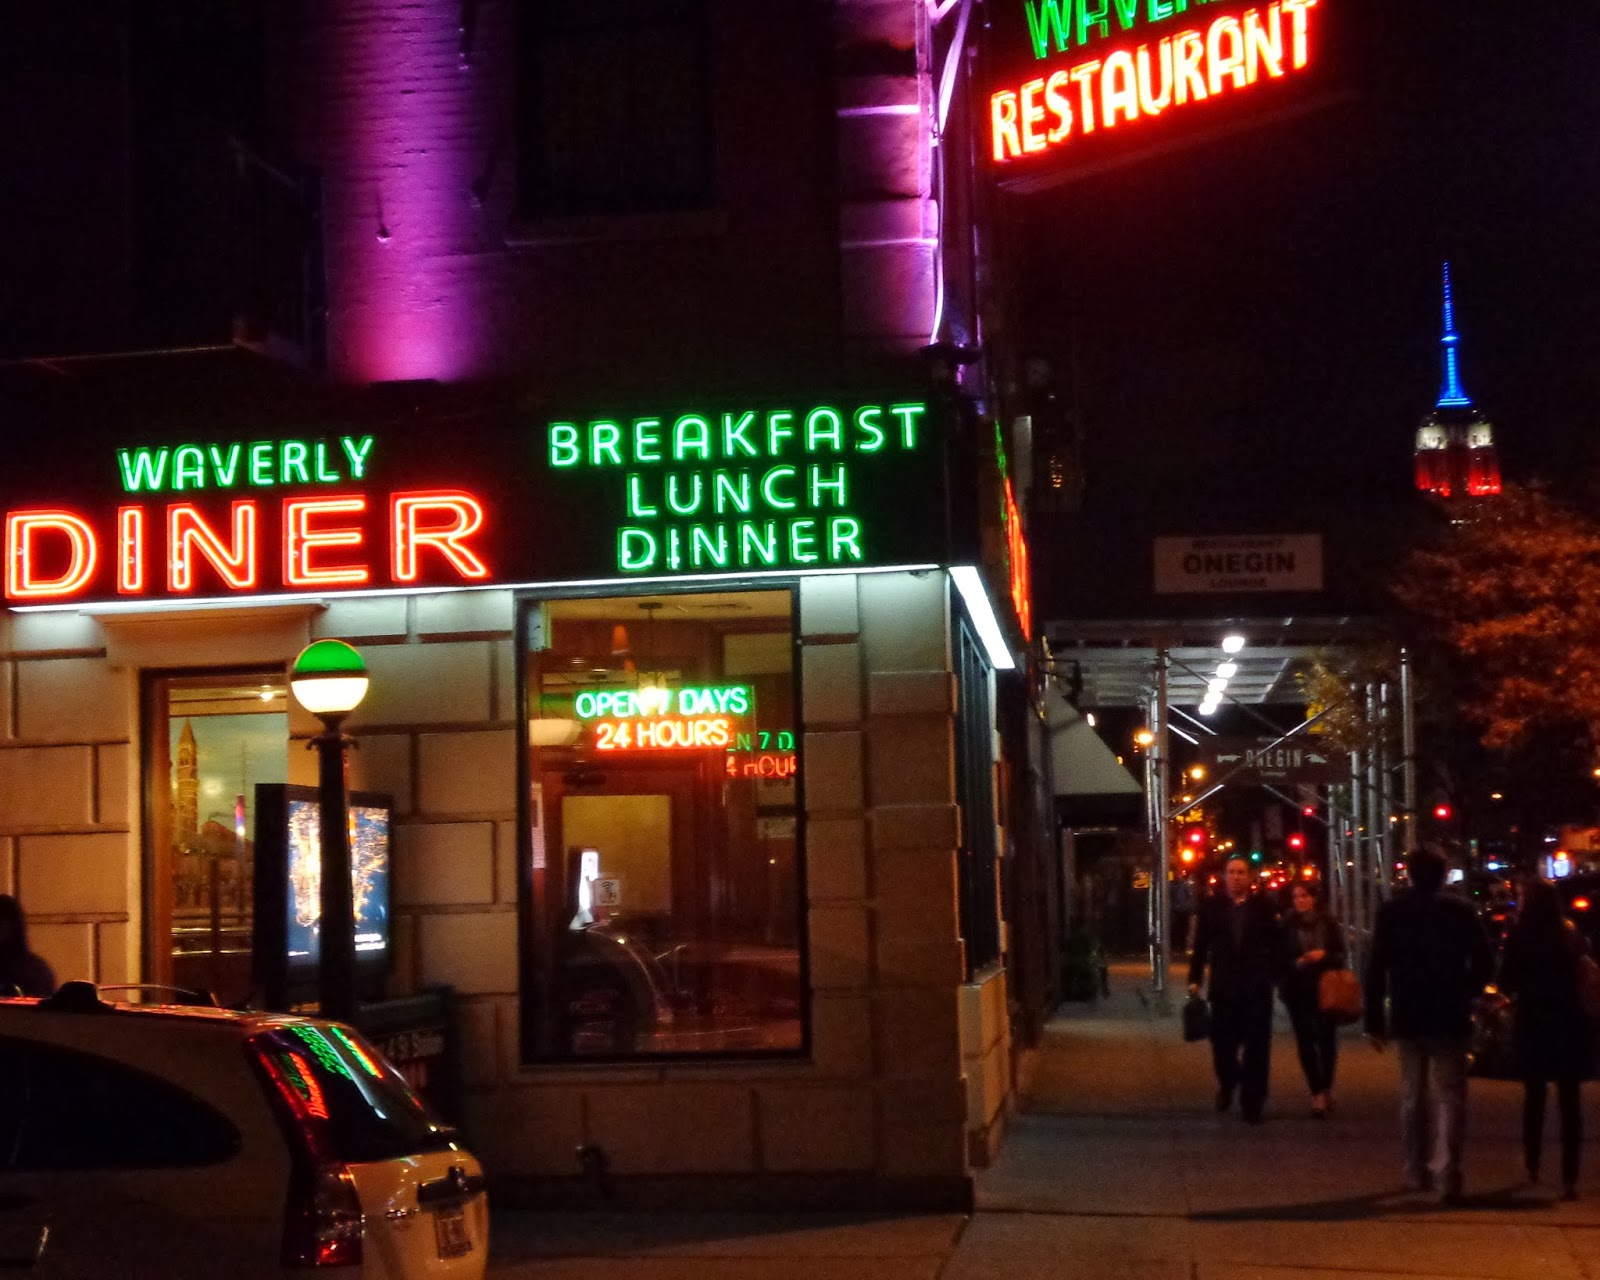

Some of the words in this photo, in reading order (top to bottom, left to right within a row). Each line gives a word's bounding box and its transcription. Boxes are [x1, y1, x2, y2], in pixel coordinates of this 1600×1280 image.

[991, 0, 1317, 161] RESTAURANT
[548, 403, 926, 467] BREAKFAST
[117, 435, 375, 491] WAVERLY
[626, 462, 846, 517] LUNCH
[5, 490, 492, 598] DINER
[617, 516, 863, 571] DINNER
[1183, 552, 1297, 574] ONEGIN
[575, 689, 650, 718] OPEN
[678, 686, 749, 716] DAYS
[596, 721, 631, 749] 24
[637, 718, 729, 748] HOURS
[758, 730, 771, 750] 7
[1245, 748, 1302, 768] ONEGIN
